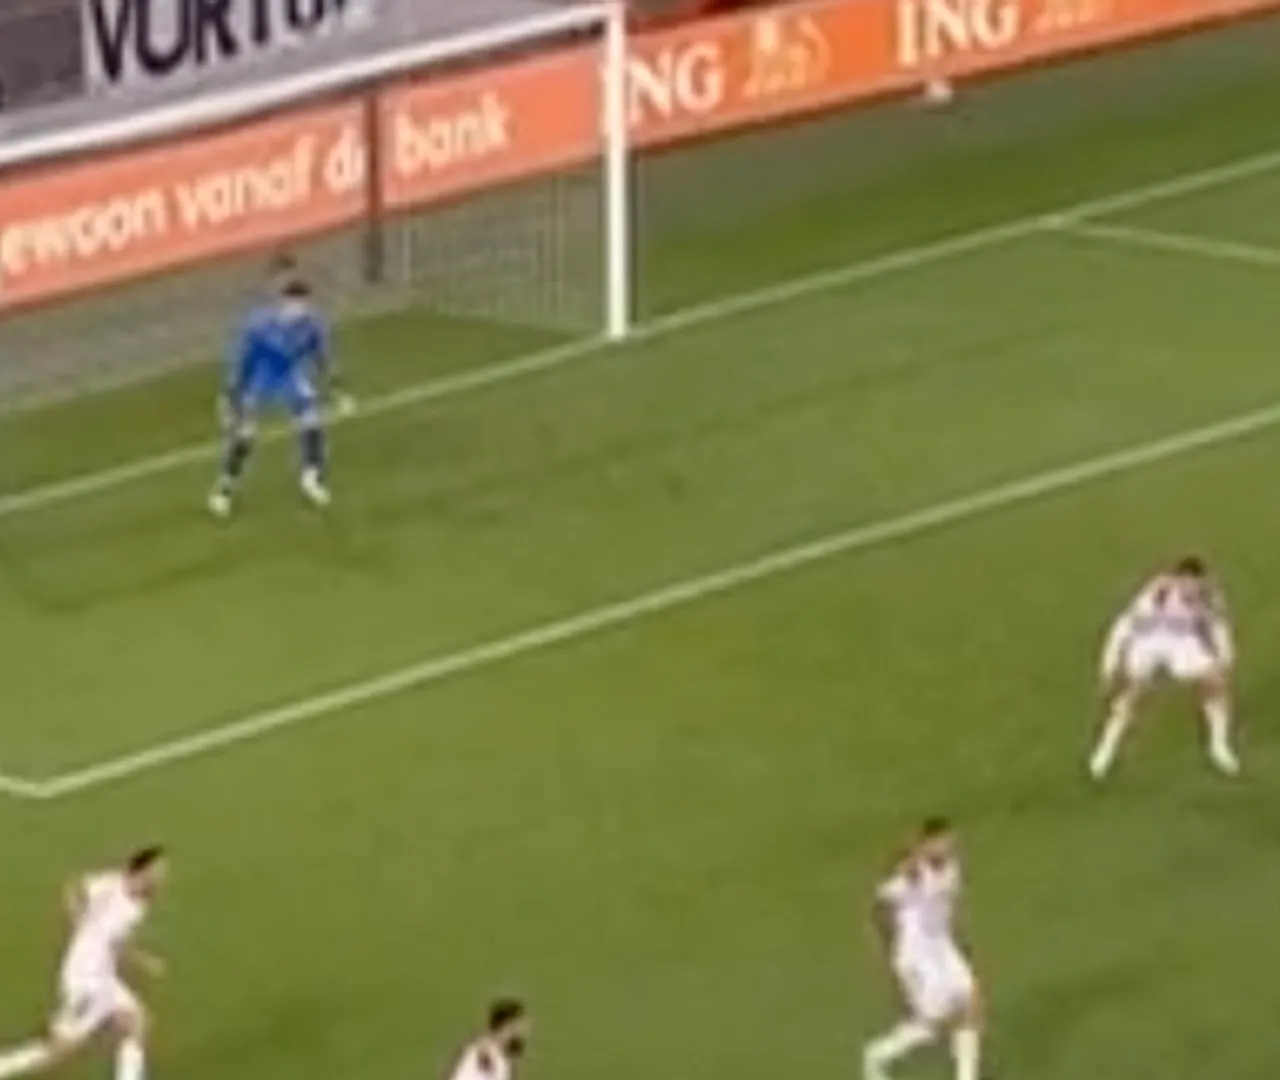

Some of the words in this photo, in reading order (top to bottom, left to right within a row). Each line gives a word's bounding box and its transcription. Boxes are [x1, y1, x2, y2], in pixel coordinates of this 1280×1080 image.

[892, 0, 1022, 66] ING
[598, 40, 726, 135] NG
[176, 134, 317, 230] vanaf
[394, 92, 512, 178] bank
